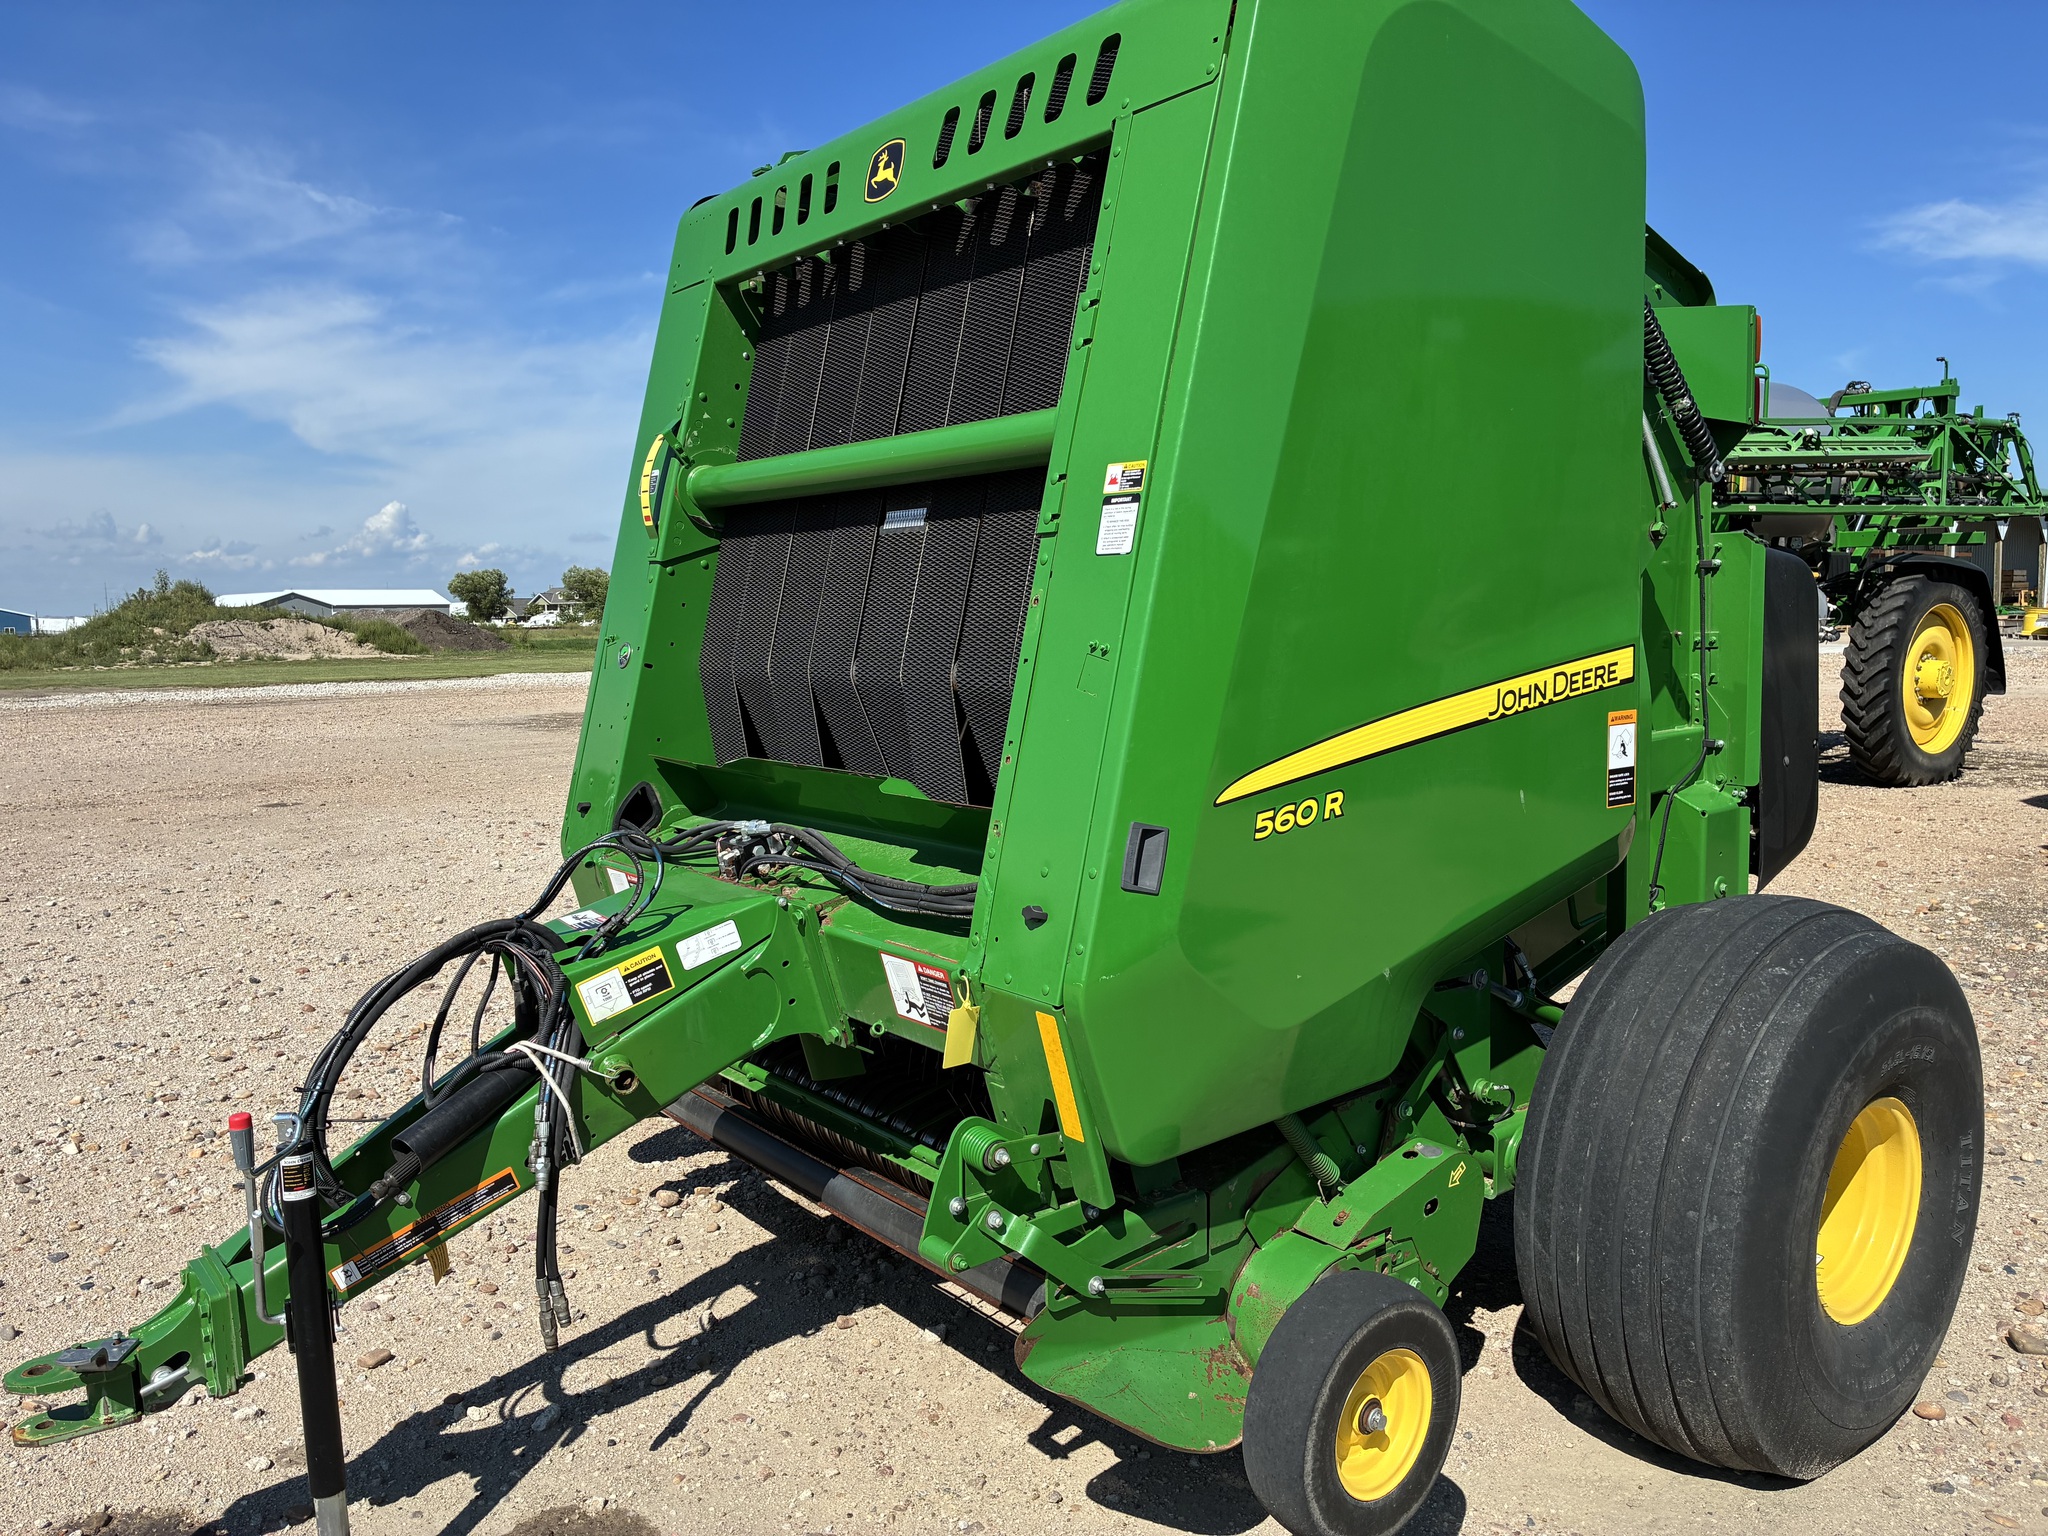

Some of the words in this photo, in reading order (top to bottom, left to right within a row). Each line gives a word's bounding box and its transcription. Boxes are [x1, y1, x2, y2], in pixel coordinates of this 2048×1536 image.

[1488, 680, 1547, 717] JOHN
[1553, 661, 1619, 698] DEERE
[1614, 713, 1634, 721] WARNING
[1254, 797, 1319, 841] 560
[1322, 789, 1345, 822] R
[629, 953, 657, 969] CAUTION
[922, 966, 945, 979] DANGER
[1950, 1129, 1973, 1248] TITAN
[420, 1202, 451, 1223] WARNING
